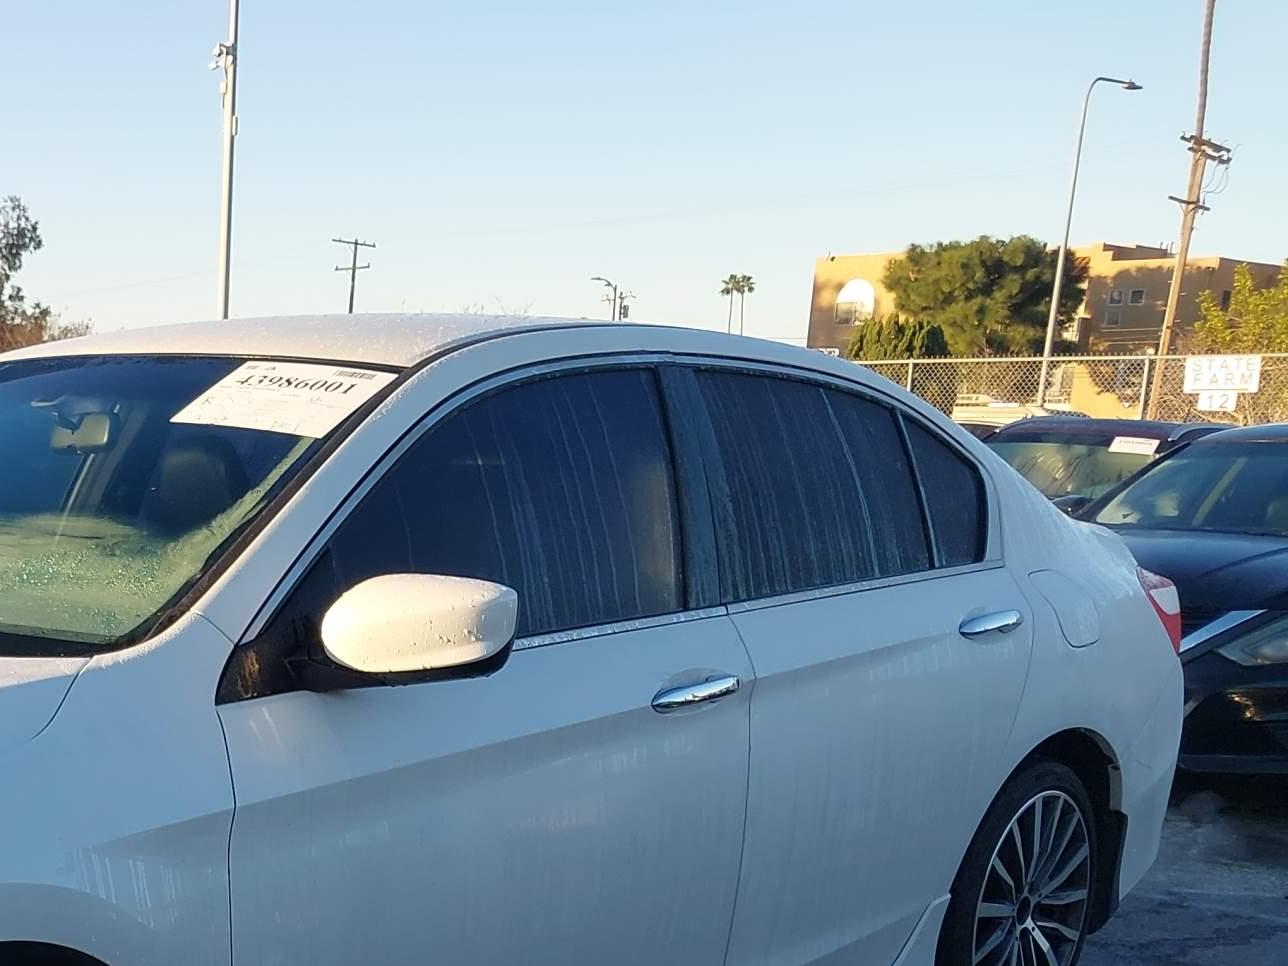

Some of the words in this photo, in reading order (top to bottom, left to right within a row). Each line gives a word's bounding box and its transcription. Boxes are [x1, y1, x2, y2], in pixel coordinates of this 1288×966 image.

[1192, 358, 1257, 373] STATE
[235, 375, 358, 395] 43986001
[1193, 373, 1253, 386] FARM
[1207, 393, 1228, 410] 12
